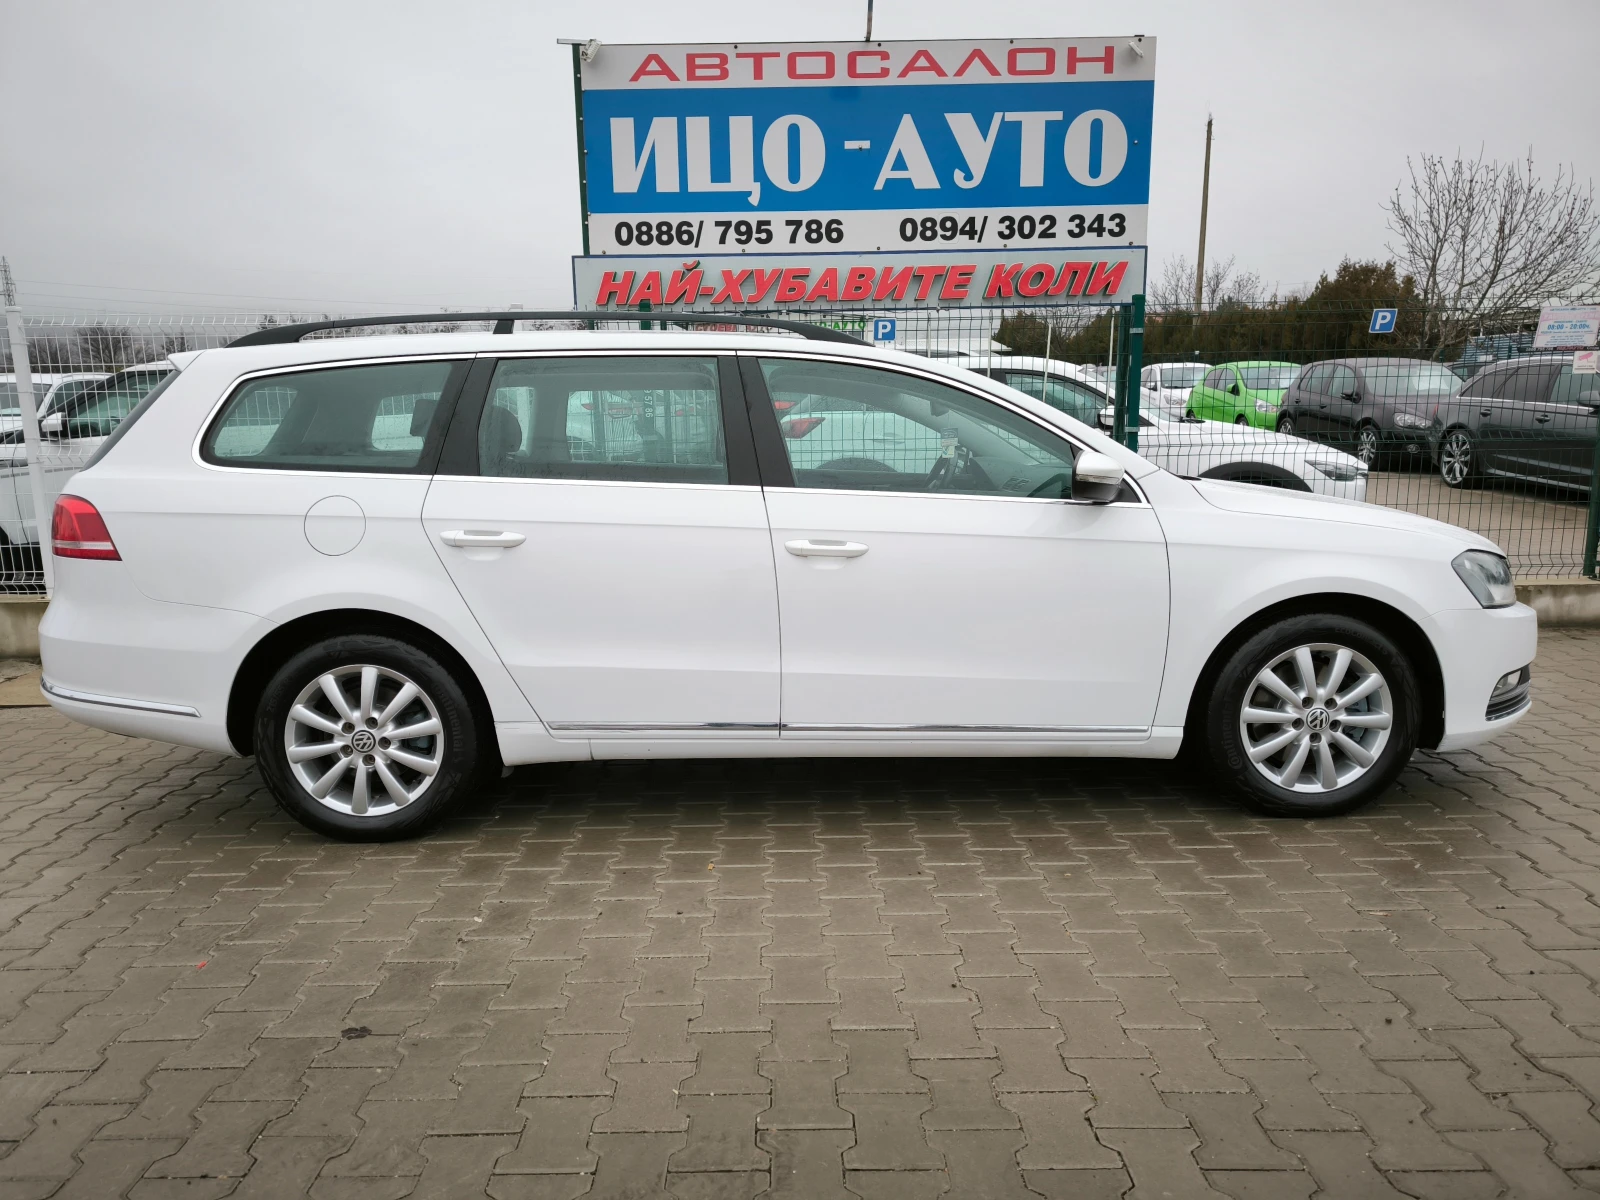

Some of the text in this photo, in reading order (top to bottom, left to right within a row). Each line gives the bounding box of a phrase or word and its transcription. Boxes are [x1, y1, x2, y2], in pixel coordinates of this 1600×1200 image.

[630, 45, 1115, 83] АВТОСАЛОН
[614, 218, 844, 248] 0886/ 795 786
[899, 213, 1126, 243] 0894/ 302 343
[595, 259, 1129, 306] НАЙ-ХУБАВИТЕ КОЛИ
[877, 321, 892, 339] P
[1375, 311, 1391, 330] P
